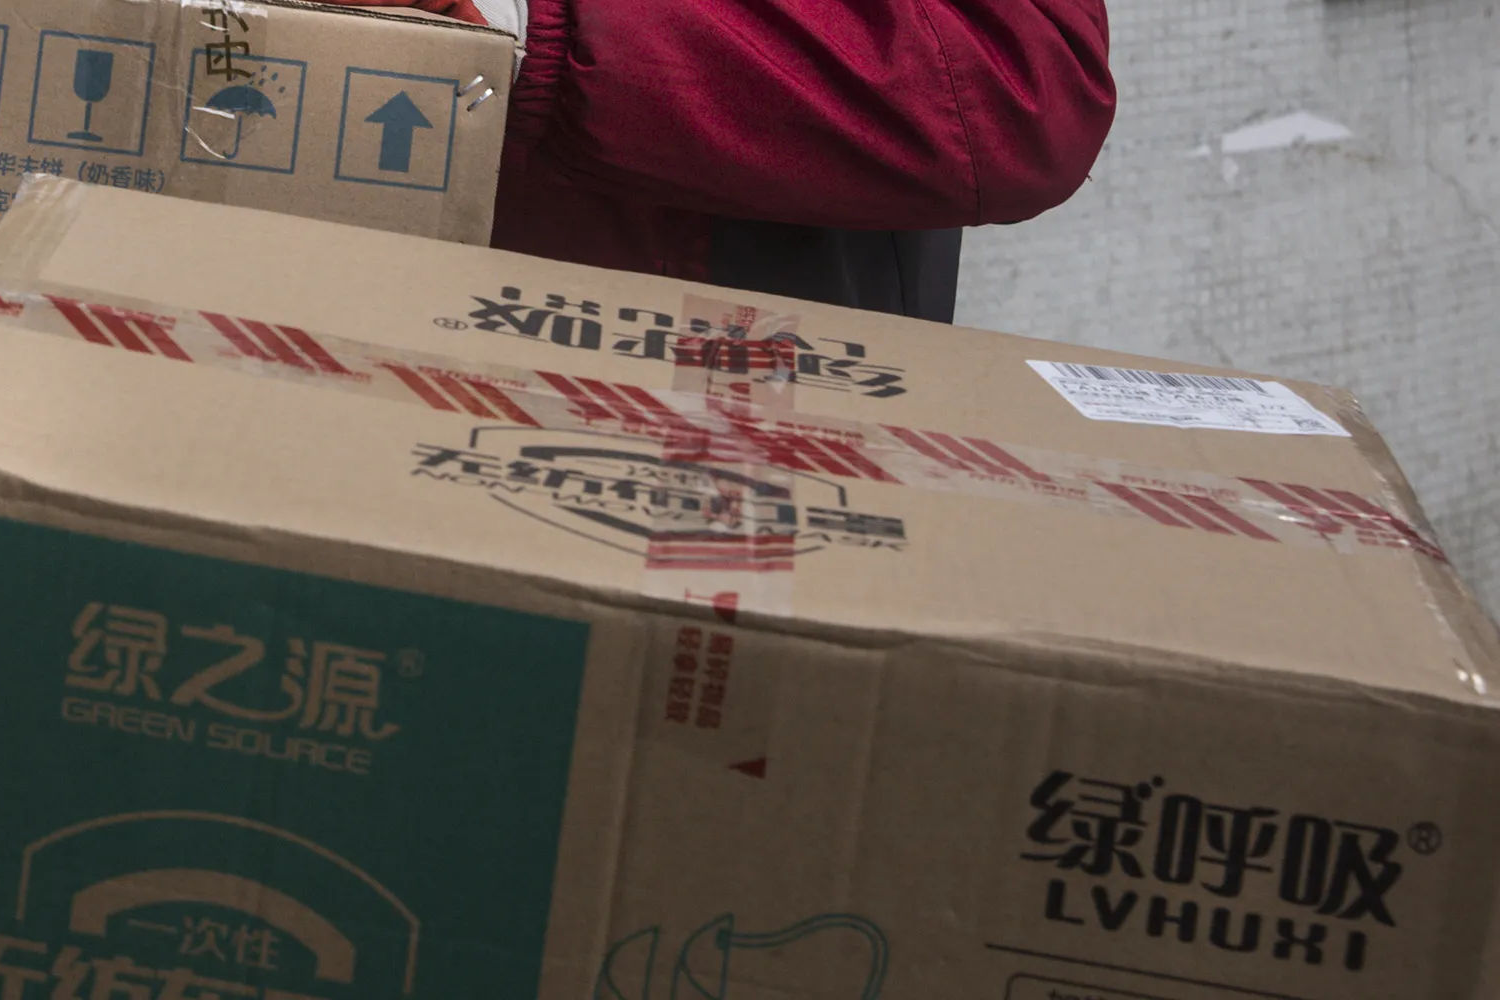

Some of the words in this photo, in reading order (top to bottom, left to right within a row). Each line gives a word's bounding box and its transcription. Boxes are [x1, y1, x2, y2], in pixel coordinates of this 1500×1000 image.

[63, 600, 400, 741] 绿之源
[60, 696, 197, 744] GREEN
[206, 722, 374, 775] SOURCE
[1018, 769, 1403, 930] 绿呼吸
[128, 916, 282, 972] 一次性
[1044, 878, 1369, 972] LVHUXI
